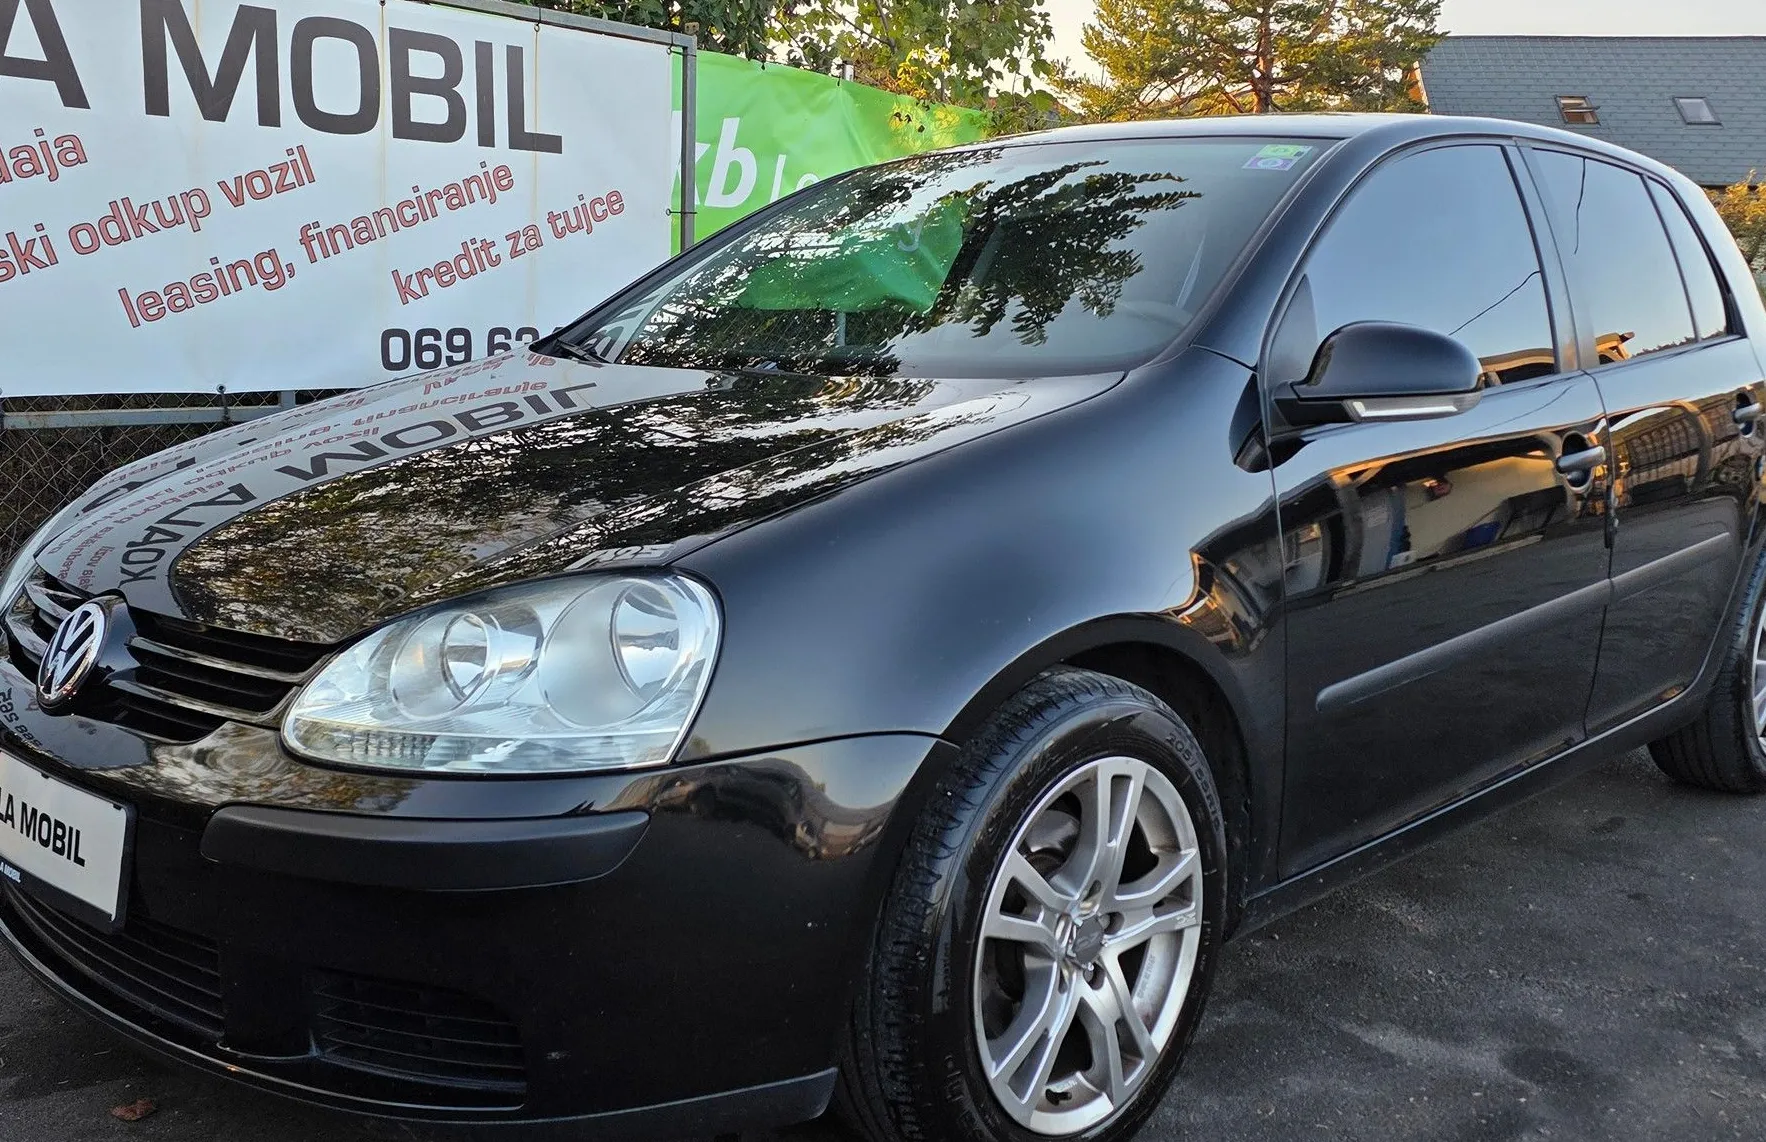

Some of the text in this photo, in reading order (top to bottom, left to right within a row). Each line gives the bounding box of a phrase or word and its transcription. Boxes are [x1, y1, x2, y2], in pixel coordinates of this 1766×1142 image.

[141, 0, 563, 154] MOBIL
[68, 196, 212, 256] odkup
[217, 144, 316, 208] vozil
[117, 160, 514, 328] leasing, financiranje
[391, 189, 625, 305] kredit za tujce
[380, 326, 472, 372] 069
[20, 801, 86, 867] MOBIL
